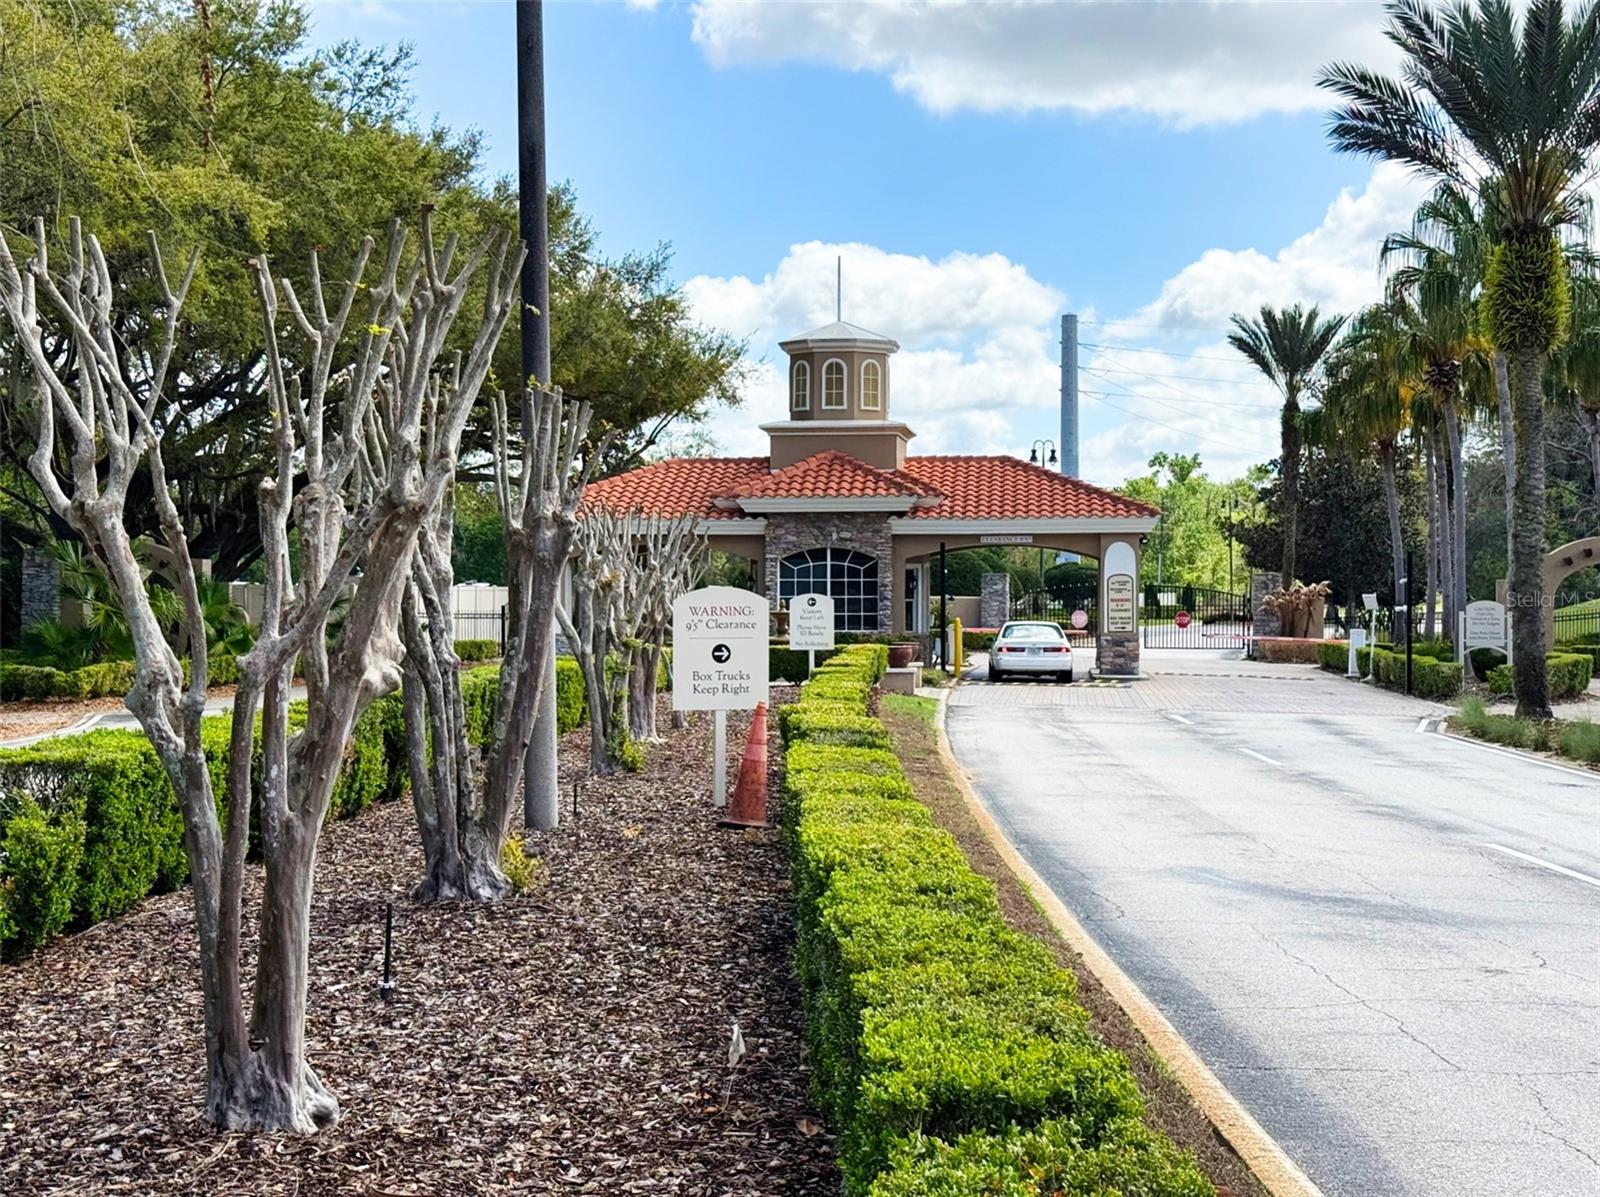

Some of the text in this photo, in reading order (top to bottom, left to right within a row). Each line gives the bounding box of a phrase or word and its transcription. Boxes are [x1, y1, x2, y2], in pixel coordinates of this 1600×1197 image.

[689, 606, 755, 617] WARNING:
[706, 619, 757, 630] Clearance
[692, 670, 751, 681] Box Trucks
[692, 683, 750, 696] Keep Right
